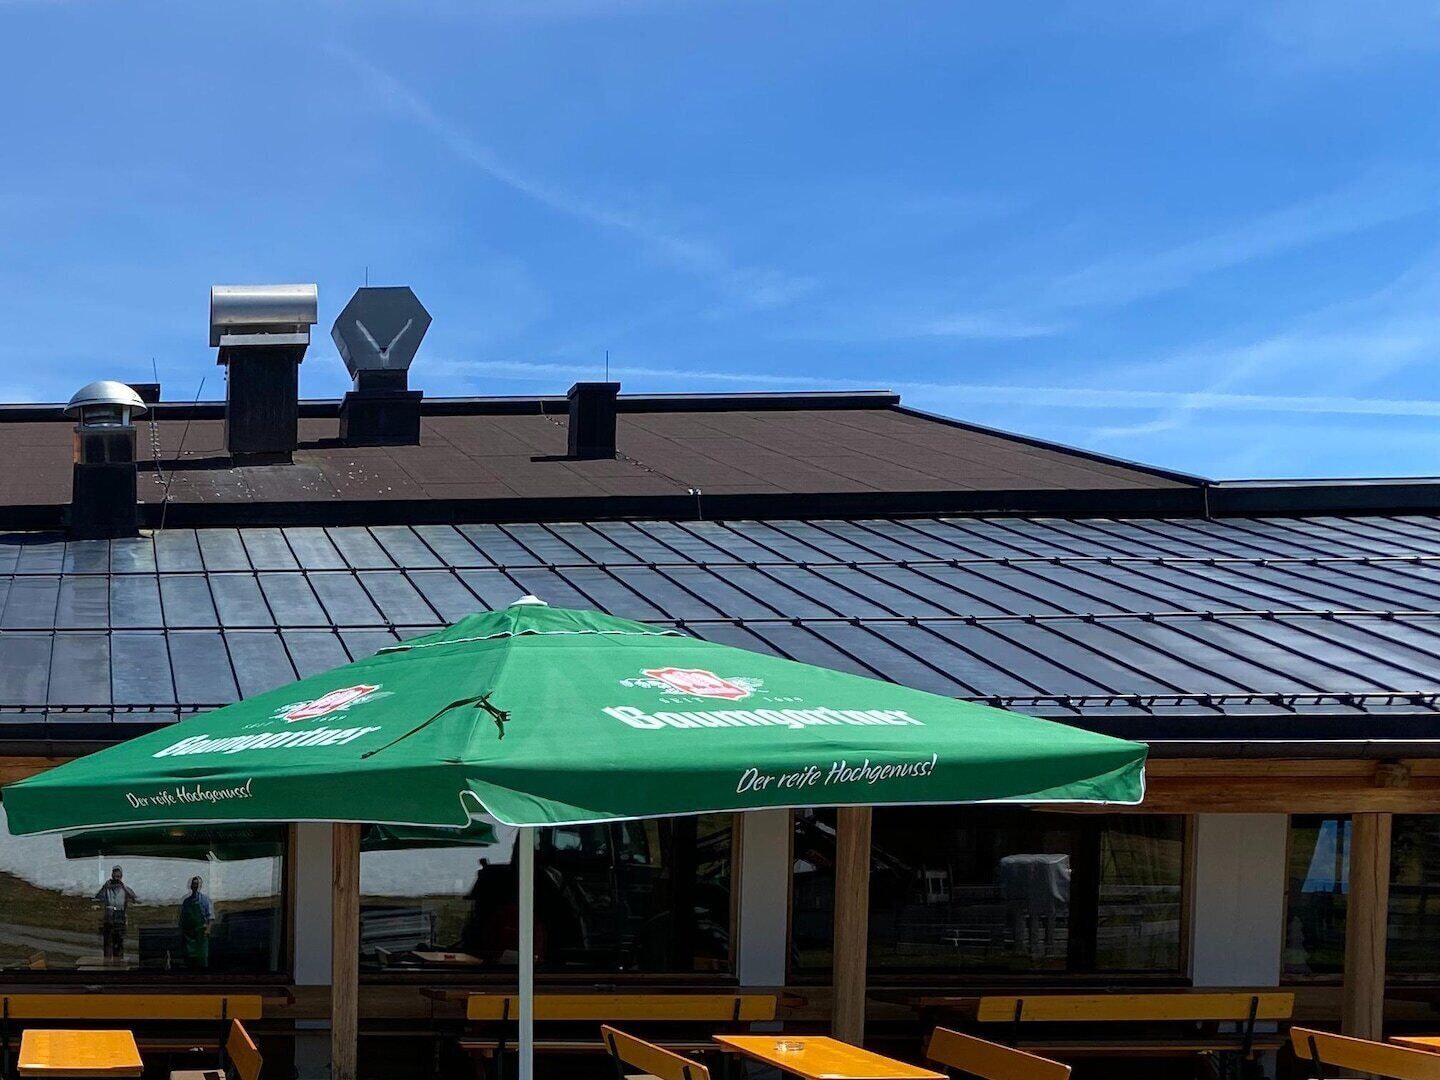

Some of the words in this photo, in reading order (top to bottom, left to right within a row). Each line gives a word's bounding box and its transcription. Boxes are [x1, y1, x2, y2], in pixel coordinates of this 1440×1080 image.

[601, 705, 927, 730] Baumgartner
[736, 767, 775, 794] Der
[777, 765, 822, 789] reife
[824, 752, 938, 785] Hochgenuss!
[125, 791, 149, 808] Der
[150, 790, 177, 806] reife
[176, 777, 253, 804] Hochgenuss!
